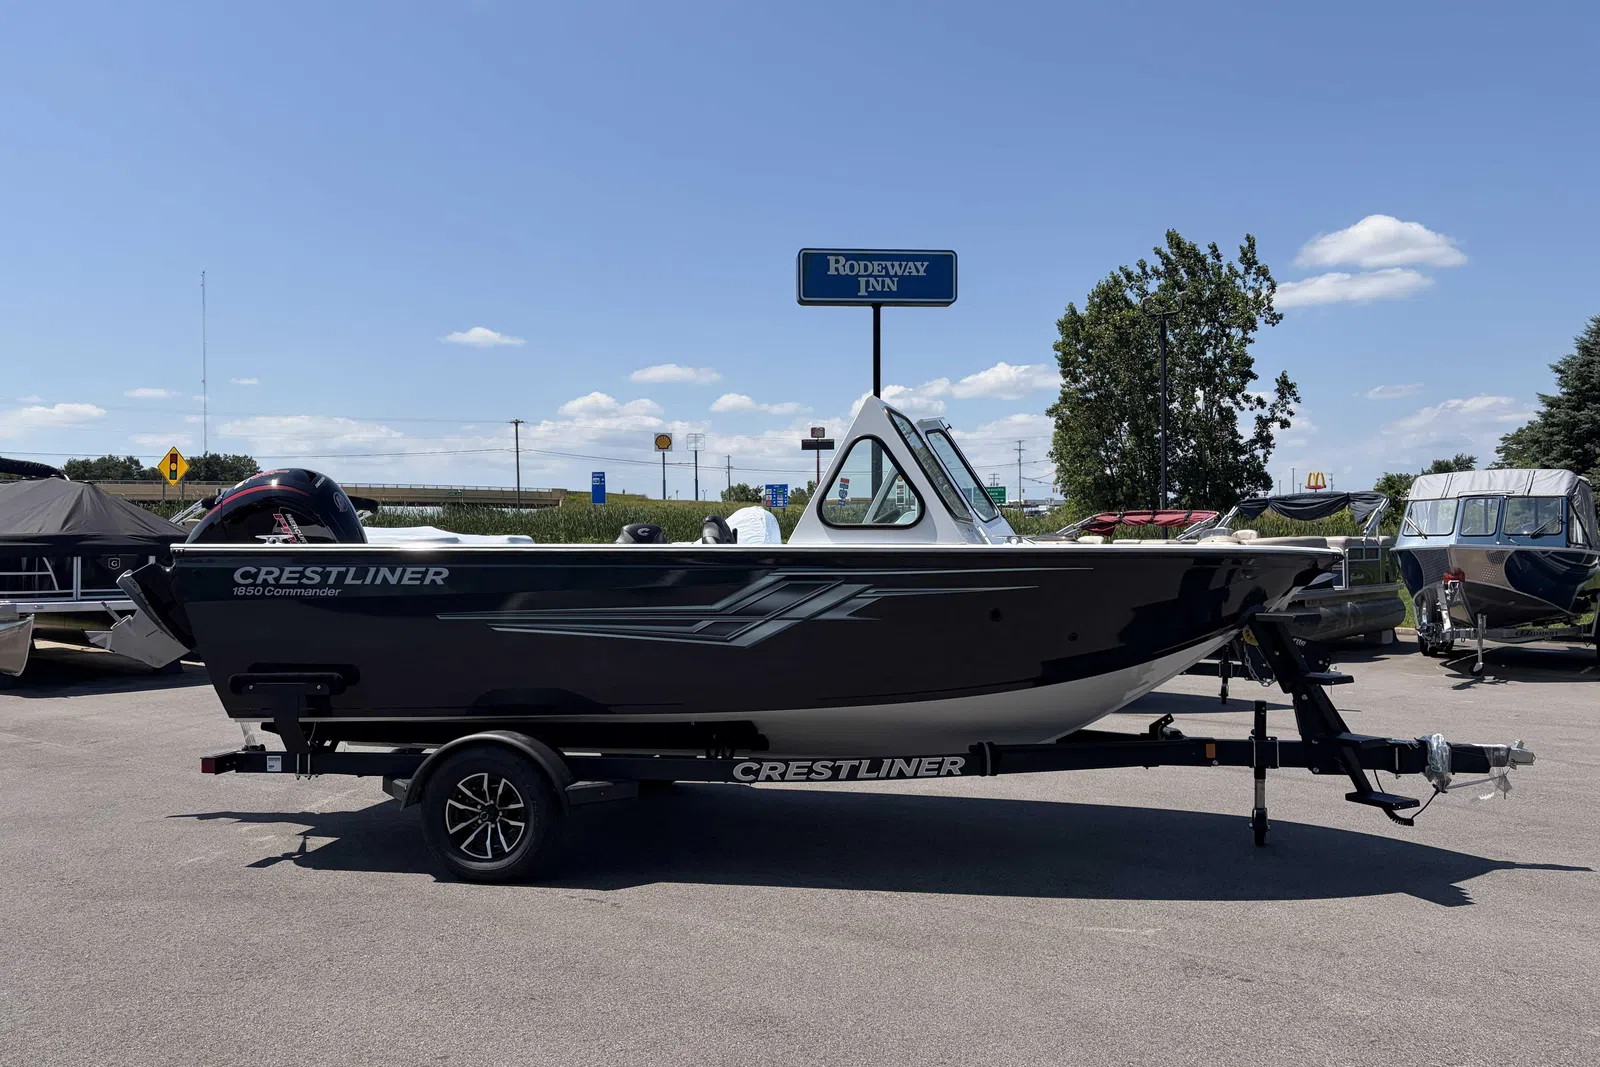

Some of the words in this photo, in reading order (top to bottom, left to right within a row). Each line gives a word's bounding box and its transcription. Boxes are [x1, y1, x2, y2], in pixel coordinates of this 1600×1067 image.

[827, 256, 929, 276] RODEWAY
[858, 277, 898, 296] INN
[285, 513, 309, 544] MERCUR
[233, 566, 450, 585] CRESTLINER
[232, 586, 263, 596] 1850
[264, 586, 342, 597] Commander
[732, 756, 966, 781] CRESTLINER
